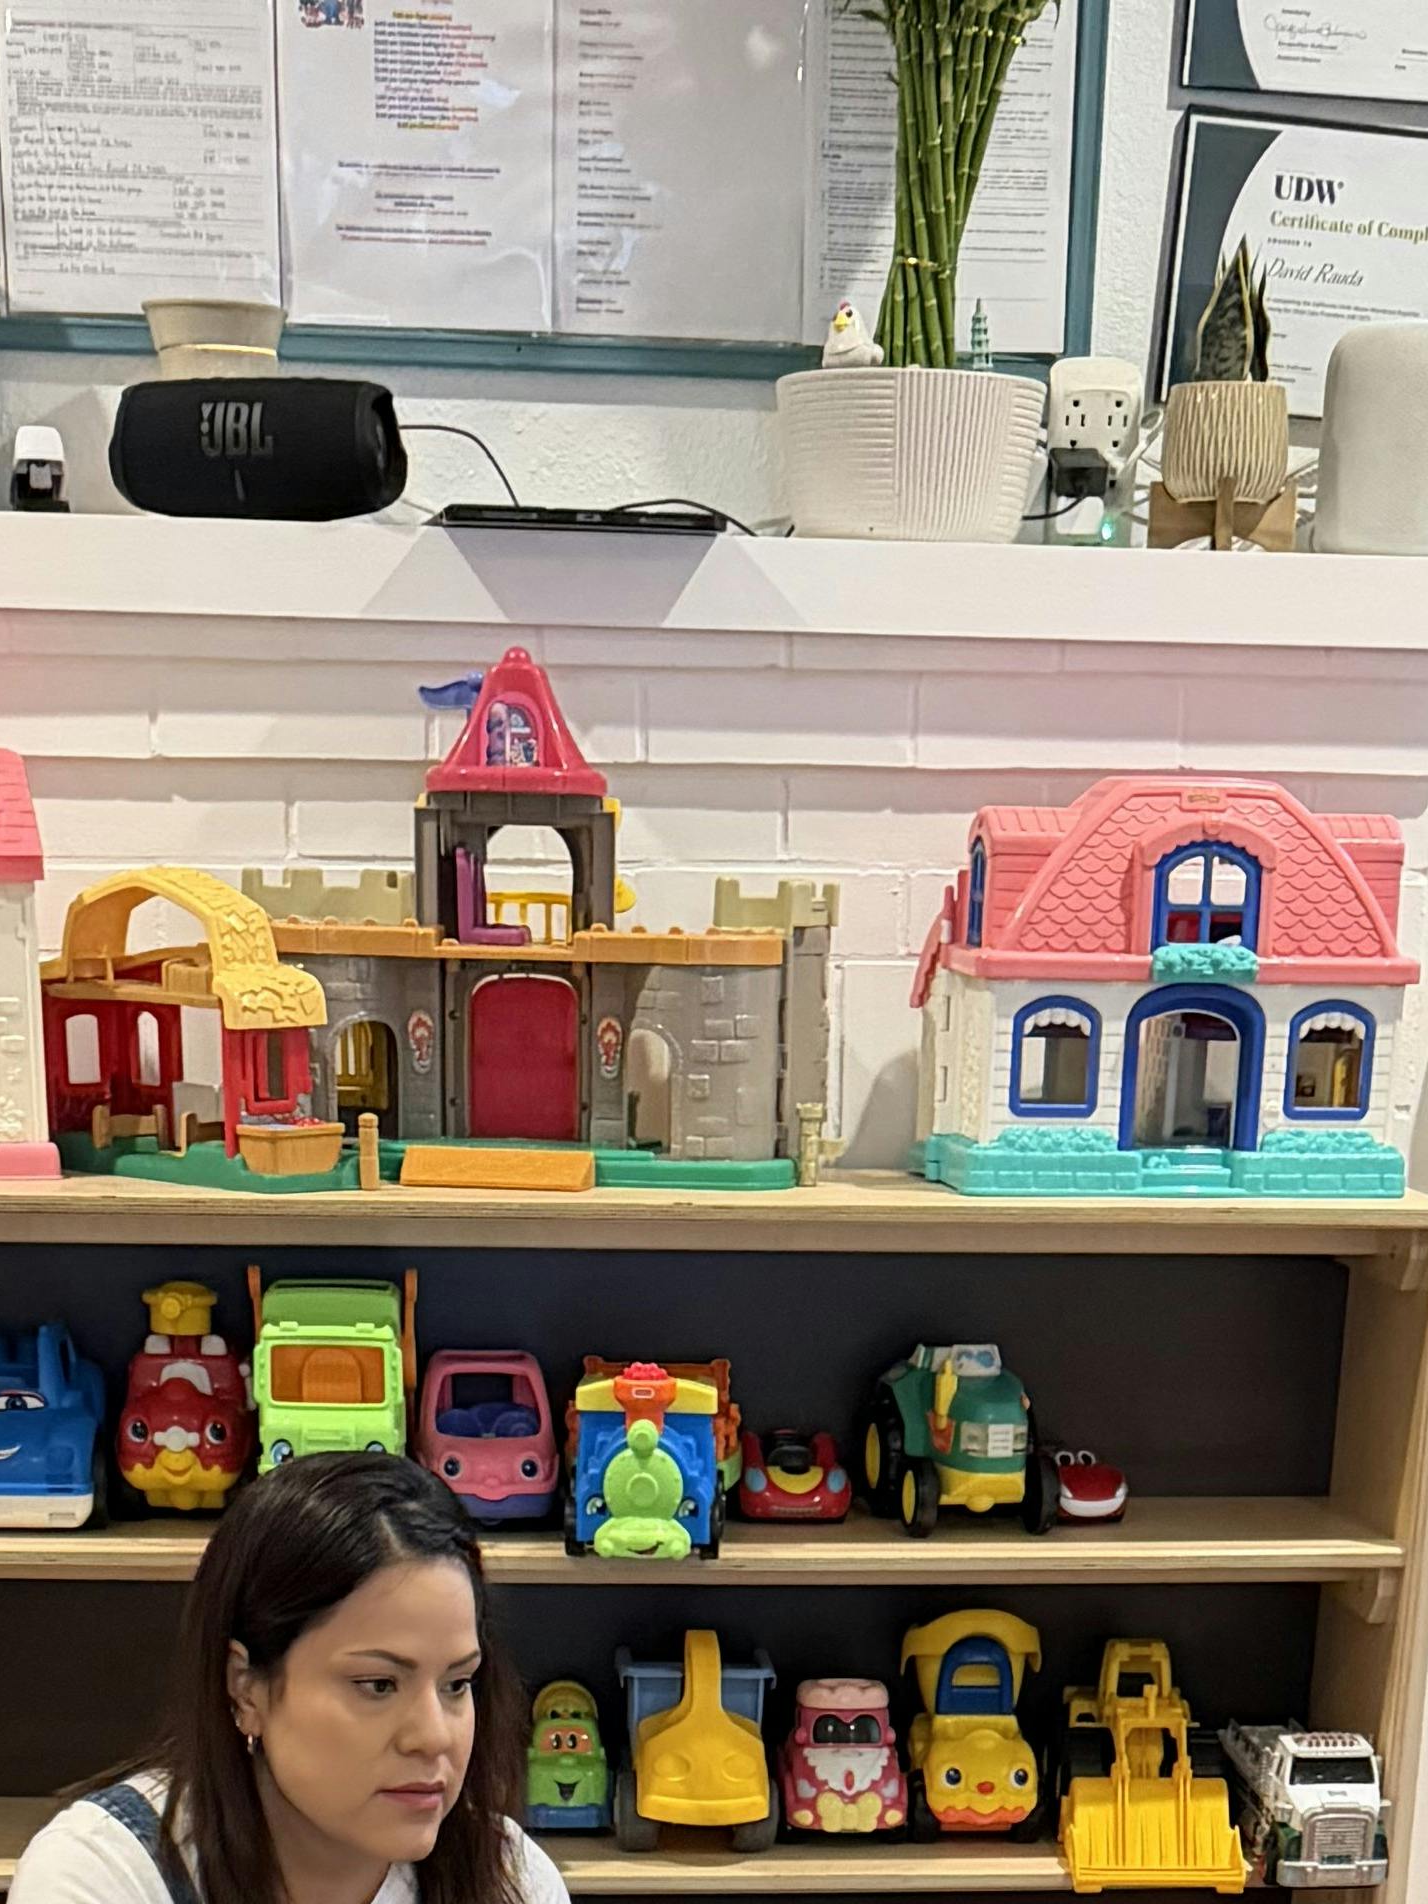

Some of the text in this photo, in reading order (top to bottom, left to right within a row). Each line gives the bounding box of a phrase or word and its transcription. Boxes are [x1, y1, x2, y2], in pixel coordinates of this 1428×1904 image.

[1274, 174, 1340, 206] UDW
[1269, 209, 1355, 236] Certificate
[1357, 219, 1376, 236] of
[1266, 257, 1365, 287] David Rauda
[200, 401, 274, 457] JBL
